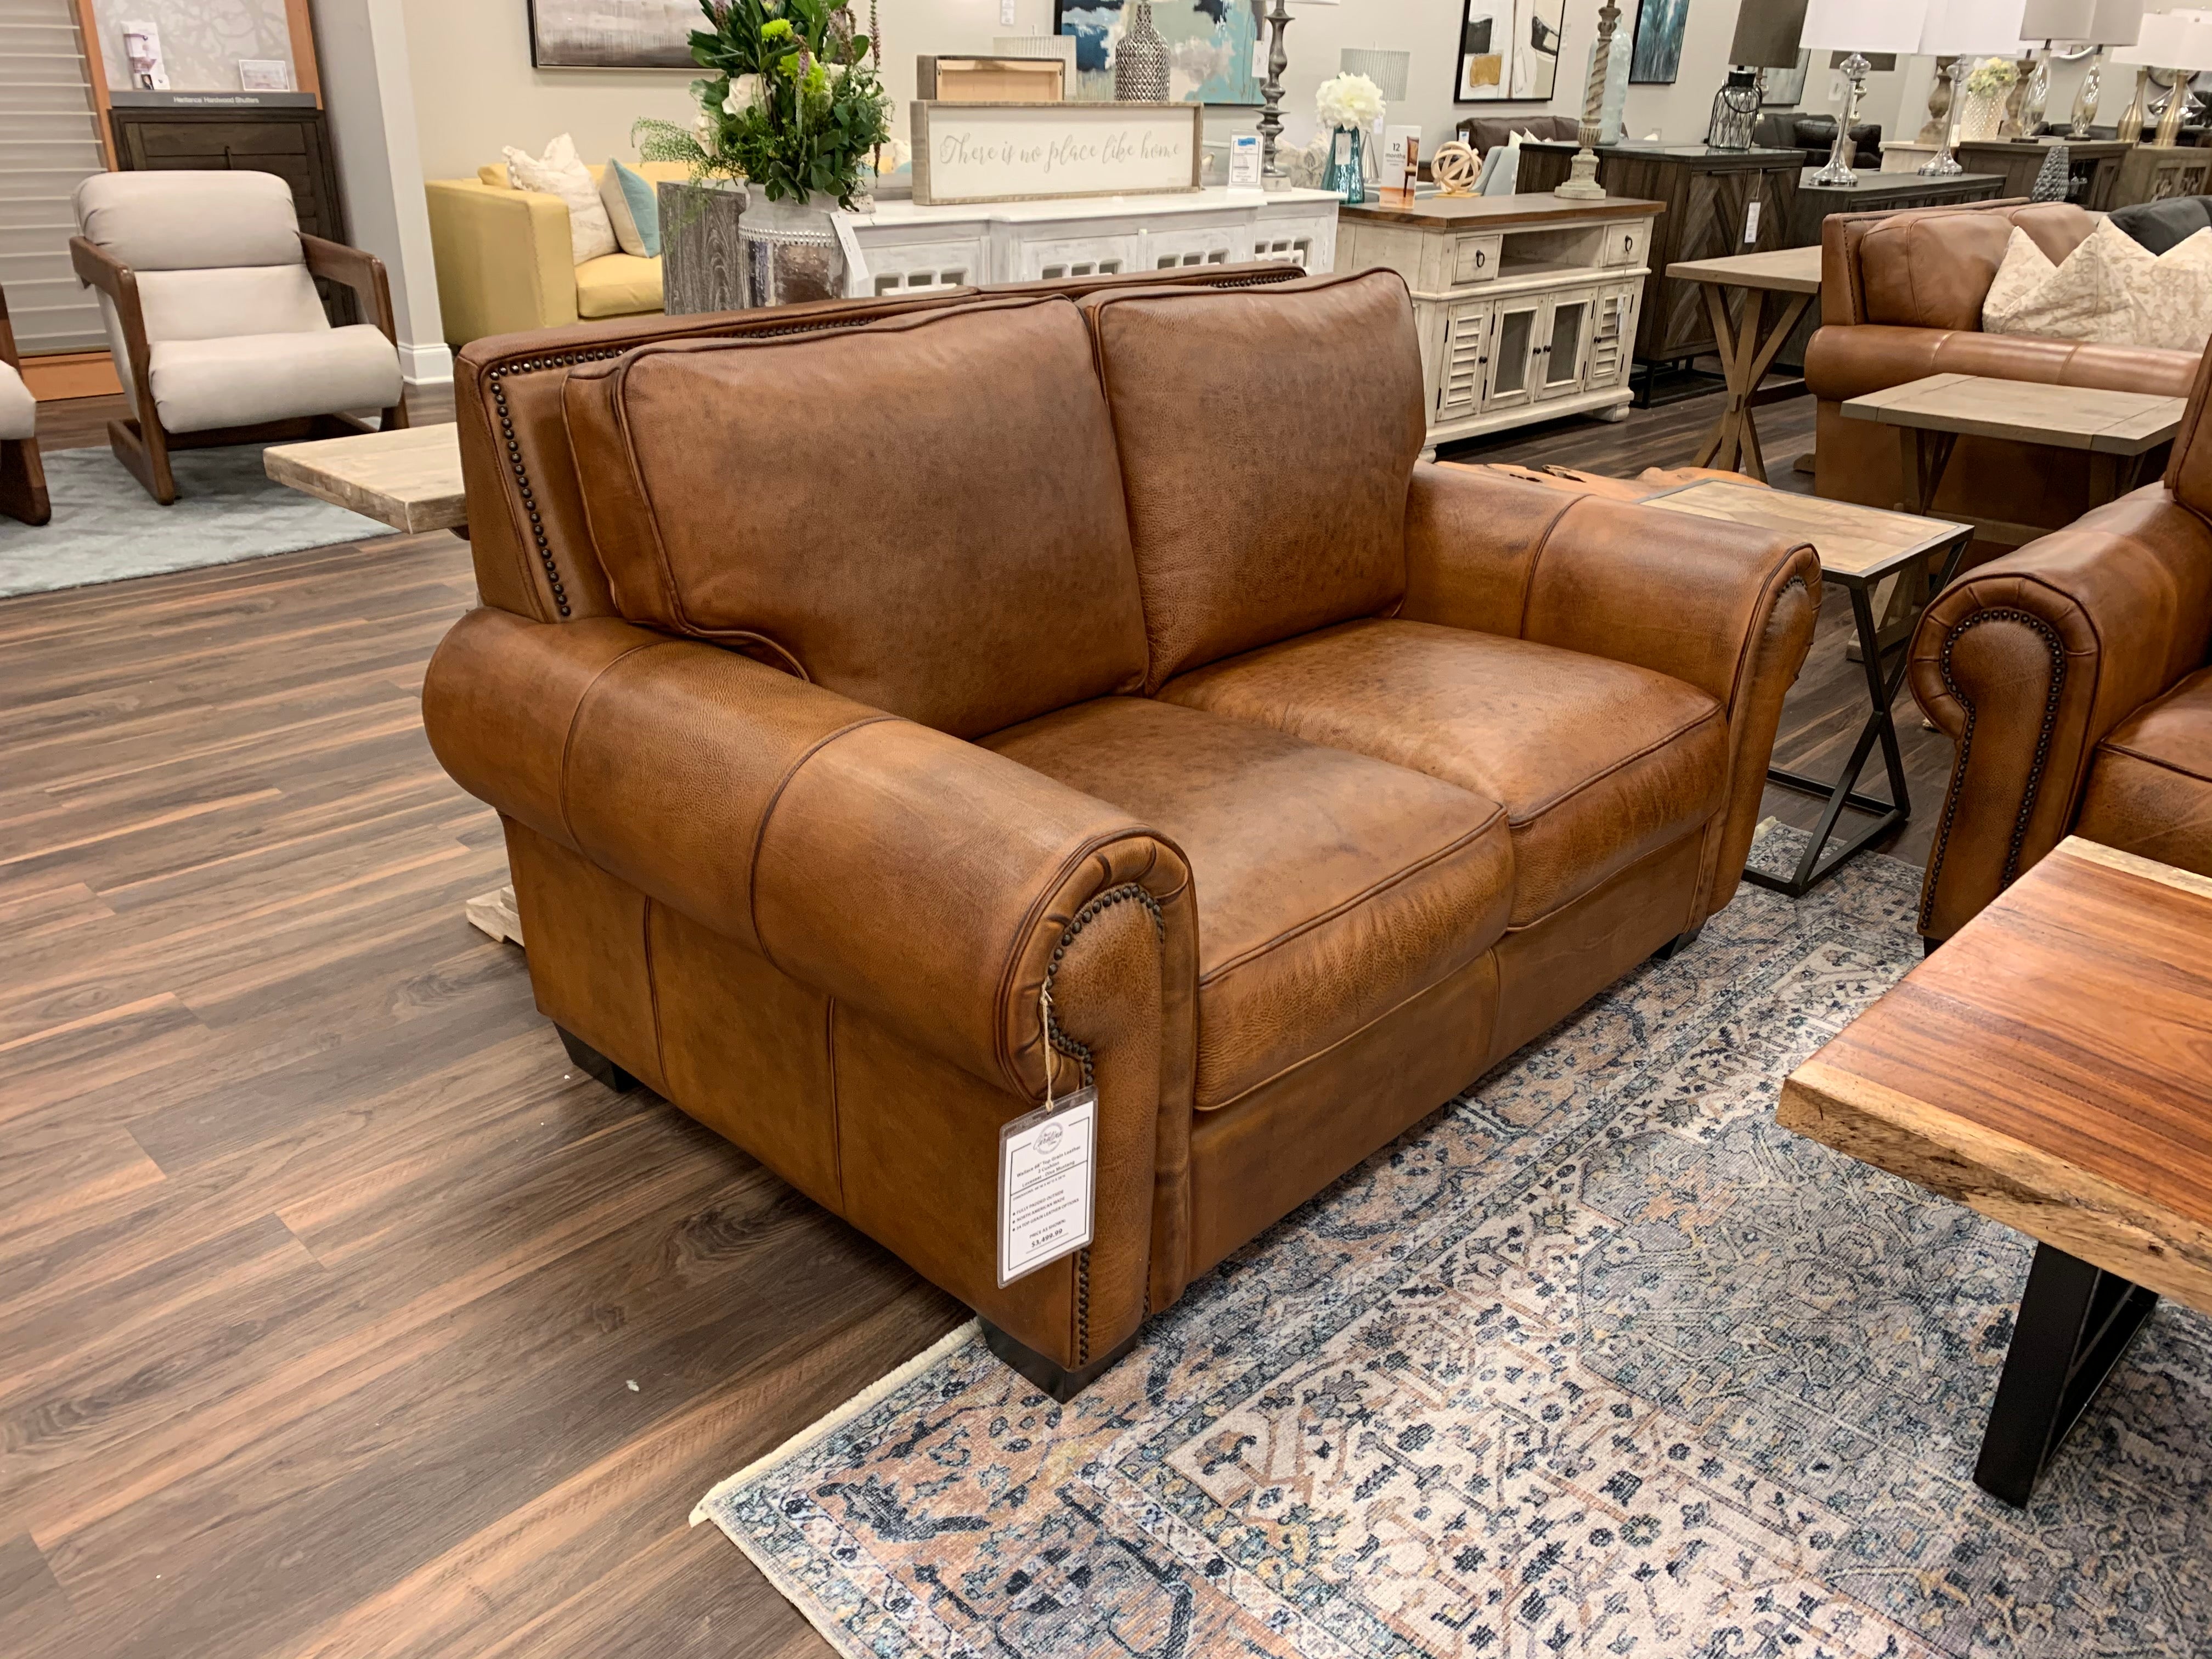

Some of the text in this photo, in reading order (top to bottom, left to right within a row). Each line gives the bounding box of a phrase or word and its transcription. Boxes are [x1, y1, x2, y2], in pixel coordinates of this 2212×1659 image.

[940, 130, 1179, 173] There is no place like home
[1392, 143, 1401, 151] 12
[1051, 1153, 1063, 1161] Grain
[1064, 1146, 1081, 1155] Leather
[1022, 1175, 1041, 1187] Loveseat
[1056, 1161, 1075, 1171] Mustang
[1042, 1161, 1059, 1171] Cushion
[1017, 1189, 1064, 1214] FULLY PADDED OUTSIDE
[1017, 1197, 1065, 1222] NORTH AMERICAN MADE
[1030, 1215, 1043, 1223] GRAIN
[1043, 1206, 1061, 1217] LEATHER
[1062, 1198, 1079, 1209] OPTIONS
[1029, 1230, 1041, 1239] PRICE
[1031, 1228, 1062, 1248] $3,499.99
